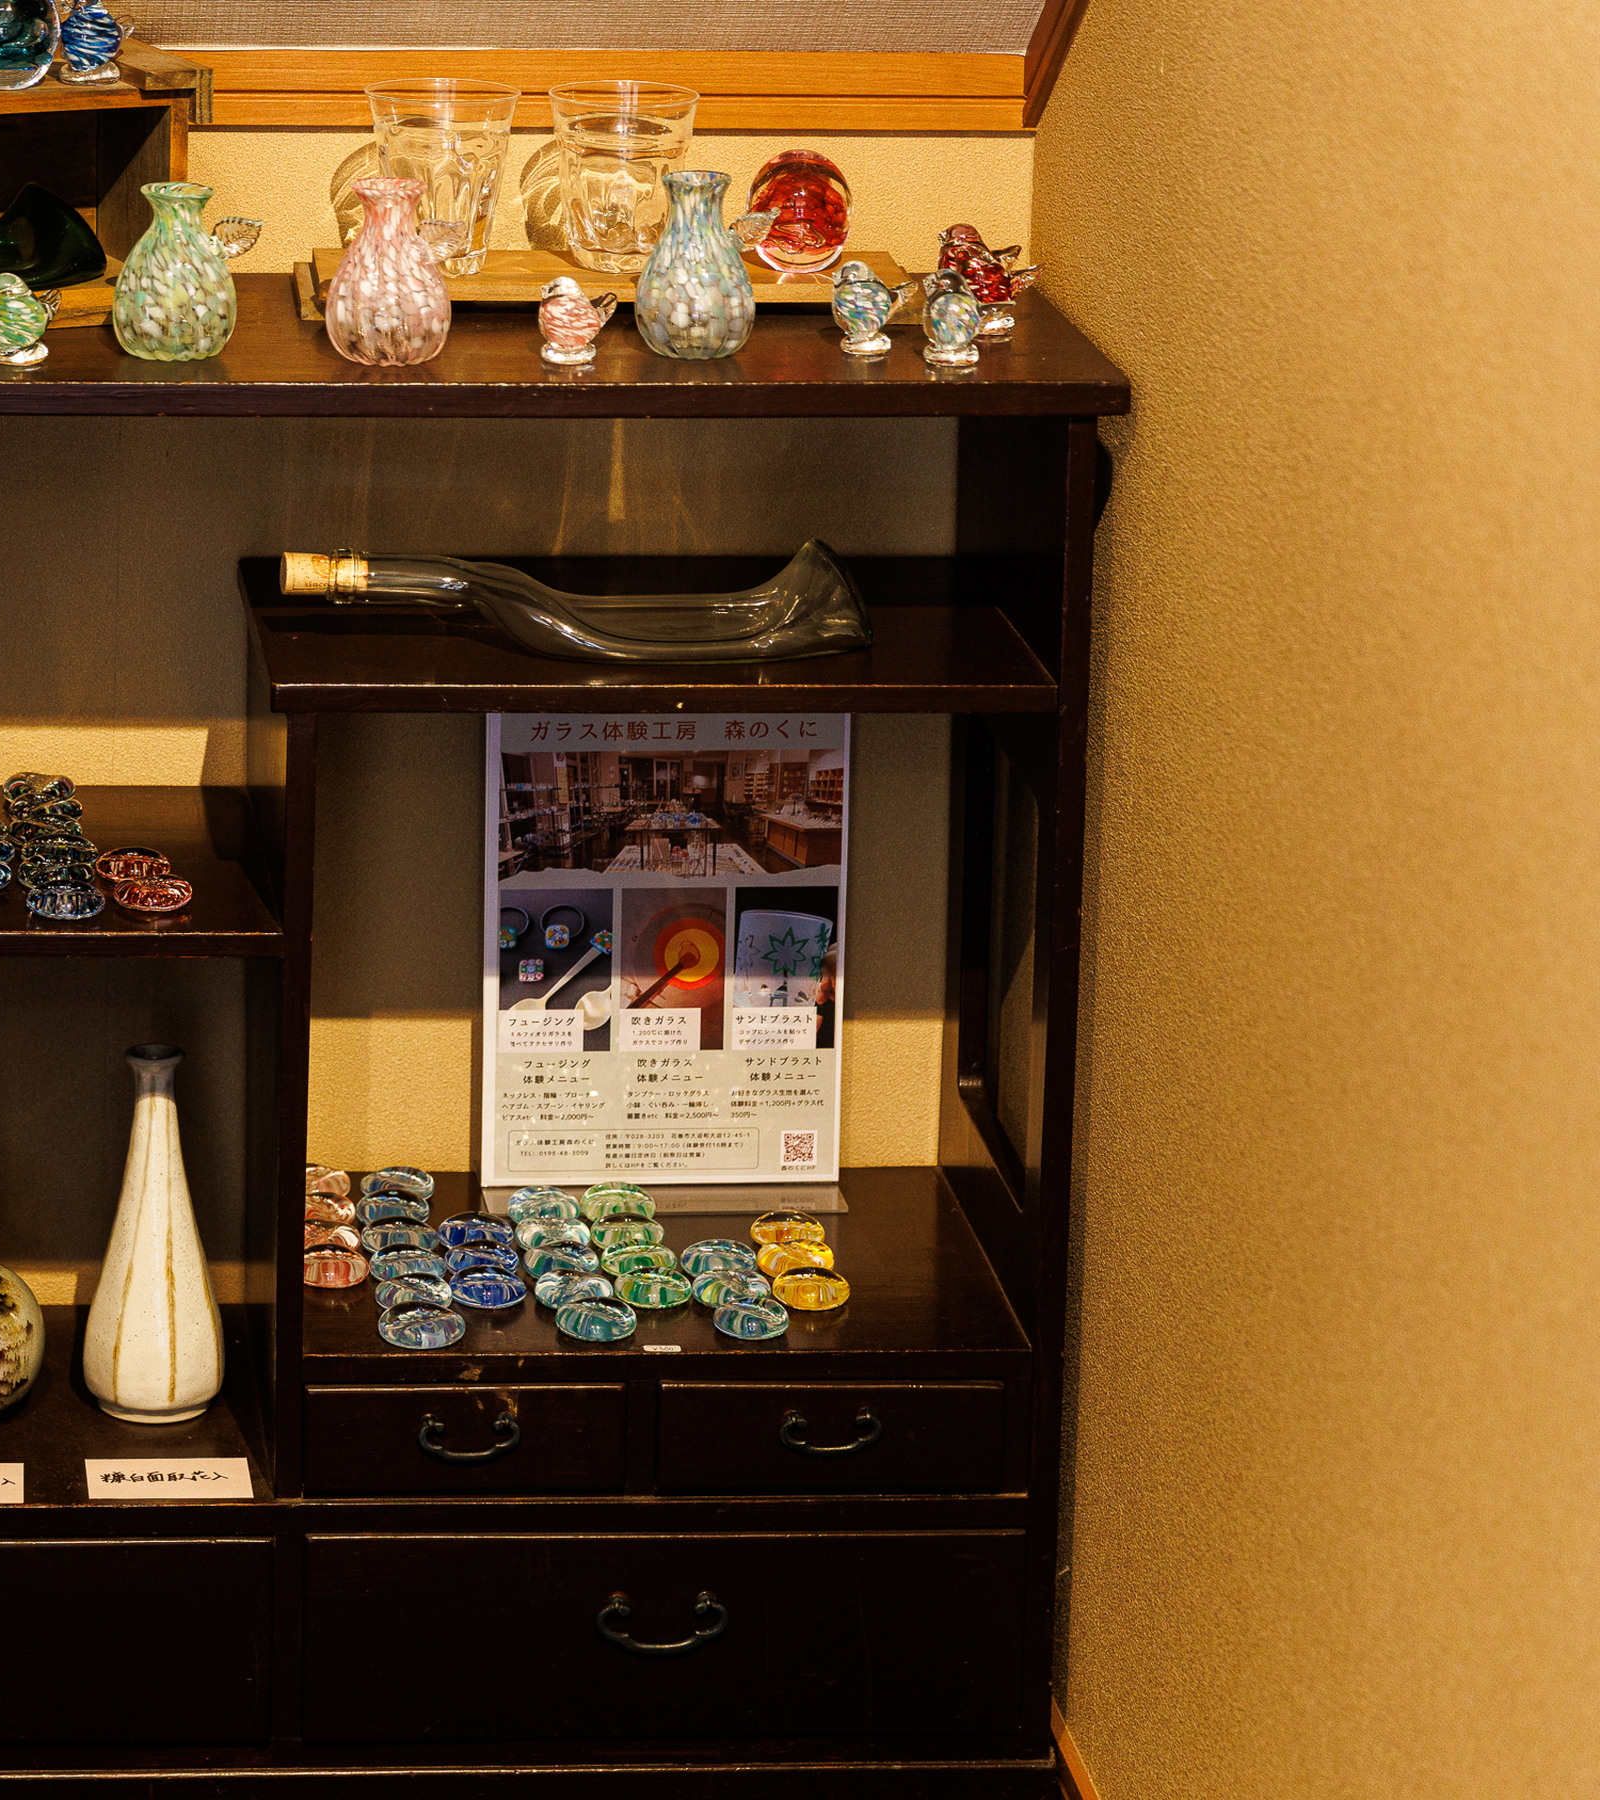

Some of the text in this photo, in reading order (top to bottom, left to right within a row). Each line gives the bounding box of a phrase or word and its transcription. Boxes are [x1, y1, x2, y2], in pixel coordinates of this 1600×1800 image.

[530, 718, 818, 742] ガラス体験工房 森のくに
[509, 1016, 576, 1028] フュージング
[631, 1016, 687, 1026] 吹きガラス
[735, 1014, 813, 1025] サンドブラスト
[524, 1058, 592, 1069] フュージング
[637, 1058, 693, 1068] 吹きガラス
[745, 1056, 823, 1067] サンドブラスト
[522, 1074, 590, 1085] 体験メニュー
[636, 1073, 704, 1083] 体験メニュー
[749, 1072, 817, 1082] 体験メニュー
